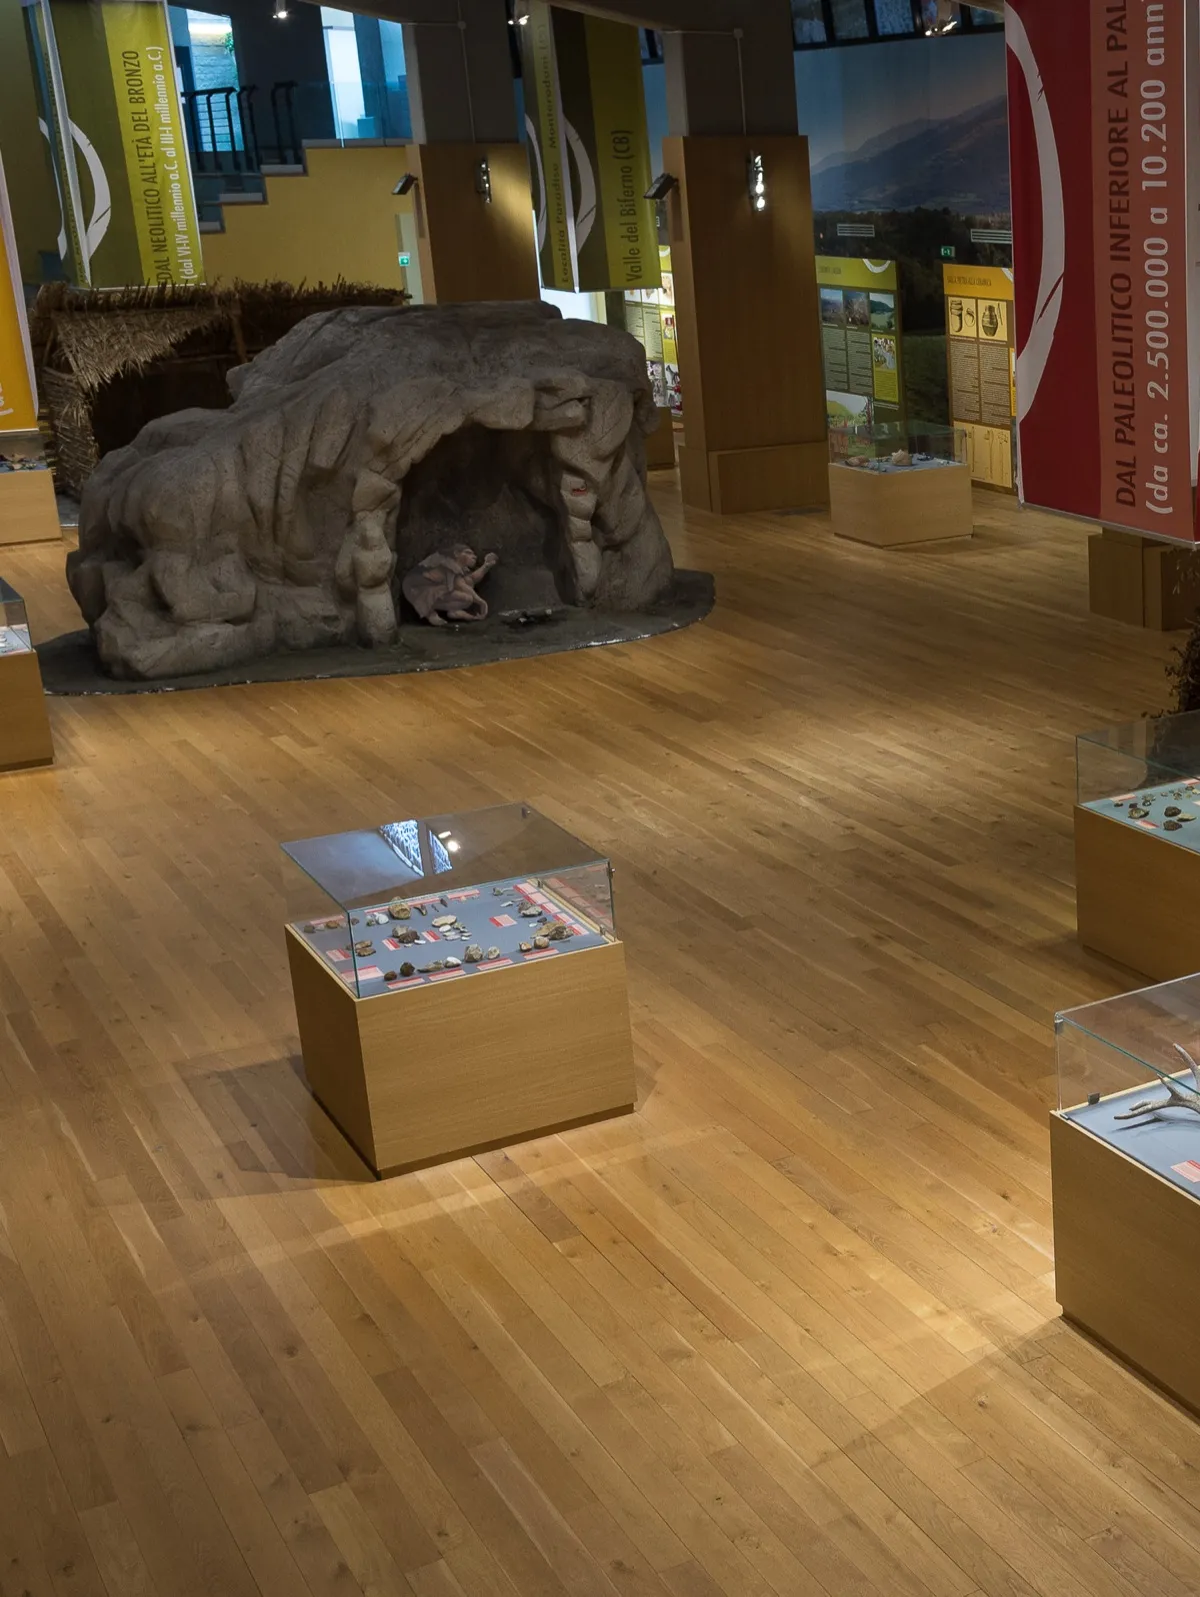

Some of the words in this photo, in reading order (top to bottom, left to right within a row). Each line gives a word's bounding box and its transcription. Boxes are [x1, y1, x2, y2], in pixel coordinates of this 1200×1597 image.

[1141, 0, 1165, 66] ann
[122, 50, 146, 104] BRONZO
[146, 46, 164, 71] a.C.)
[1107, 61, 1128, 98] AL
[132, 108, 149, 132] DEL
[155, 74, 171, 124] millennio
[160, 146, 176, 157] al
[611, 129, 635, 161] (CB)
[1140, 79, 1167, 191] 10.200
[164, 160, 179, 180] a.C.
[550, 163, 564, 224] Paradiso
[618, 165, 637, 219] Biferno
[1108, 108, 1130, 262] INFERIORE
[146, 187, 168, 252] NEOLITICO
[170, 181, 188, 231] millennio
[1150, 207, 1168, 225] a
[175, 234, 191, 256] VI-IV
[619, 220, 640, 242] del
[178, 259, 198, 279] (dal
[621, 241, 643, 283] Valle
[1143, 237, 1169, 401] 2.500.000
[1110, 272, 1136, 446] PALEOLITICO
[1153, 413, 1168, 454] ca.
[1116, 456, 1137, 508] DAL
[1145, 465, 1173, 514] (da
